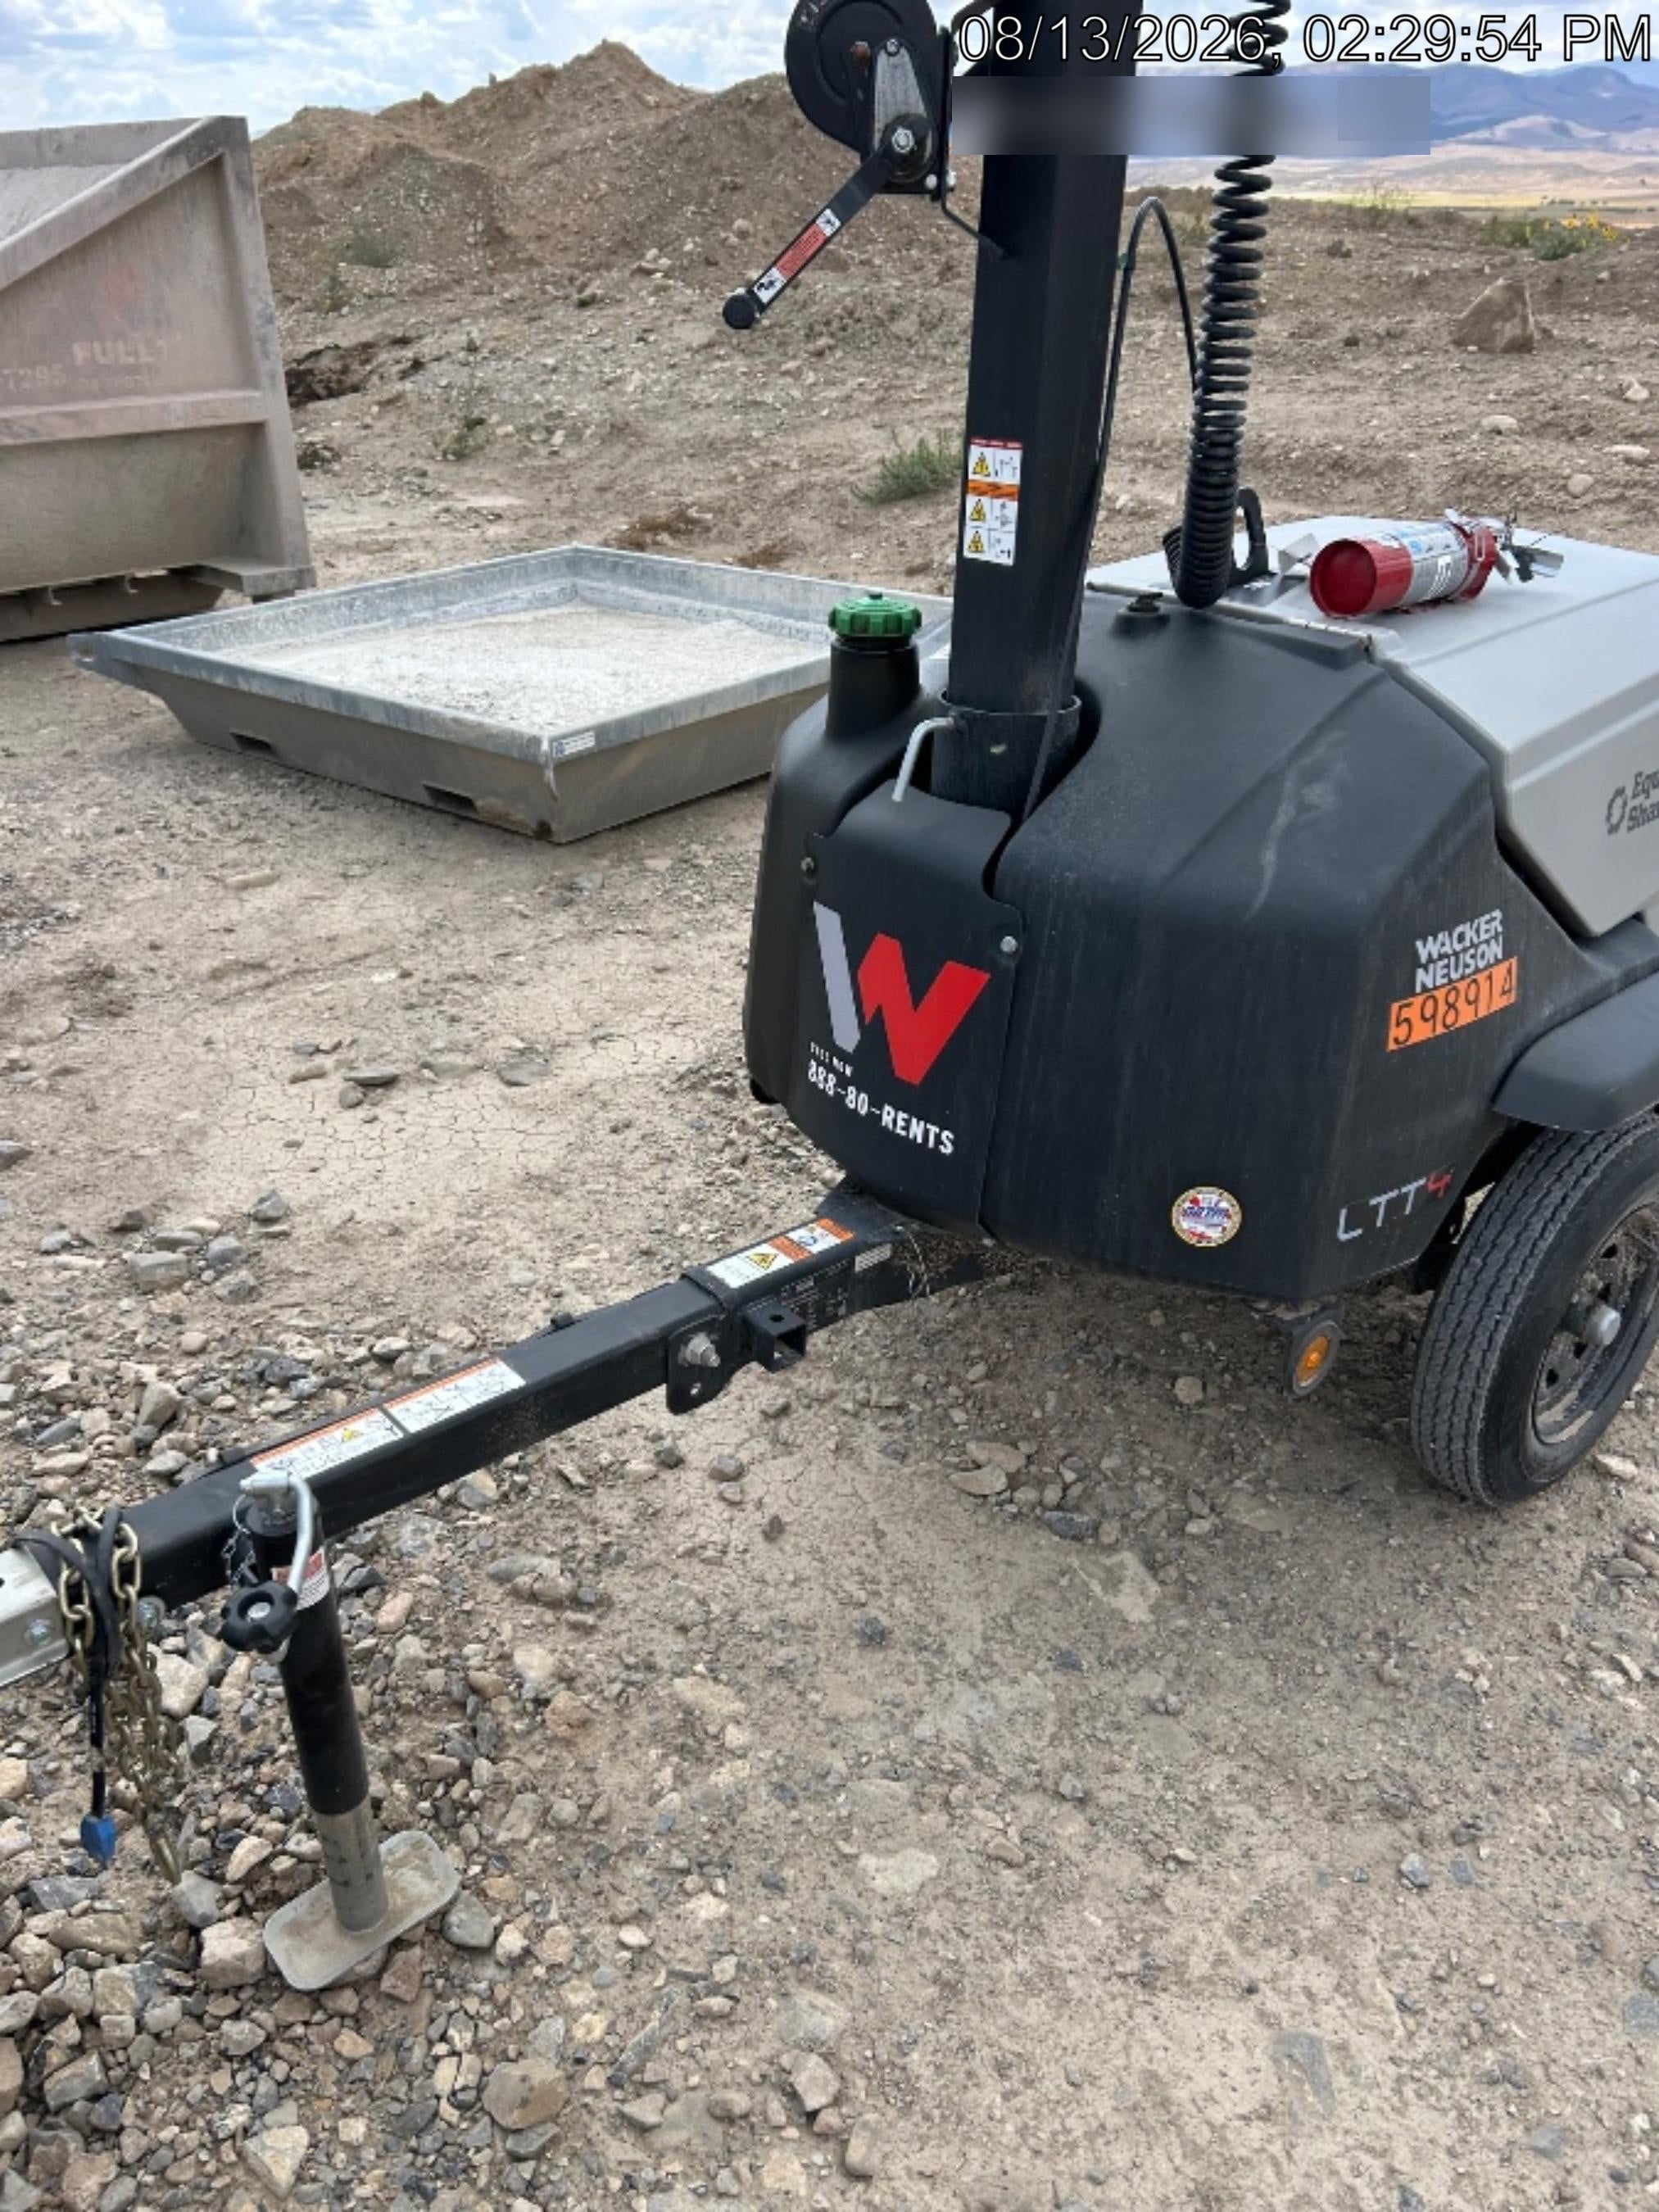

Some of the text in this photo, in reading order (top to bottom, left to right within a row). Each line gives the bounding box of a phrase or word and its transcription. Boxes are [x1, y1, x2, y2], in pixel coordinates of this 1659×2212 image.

[1415, 909, 1503, 964] WACKER
[1415, 934, 1503, 994] NEUSON
[1393, 961, 1513, 1045] 598914
[807, 1058, 955, 1157] 888-80-RENTS
